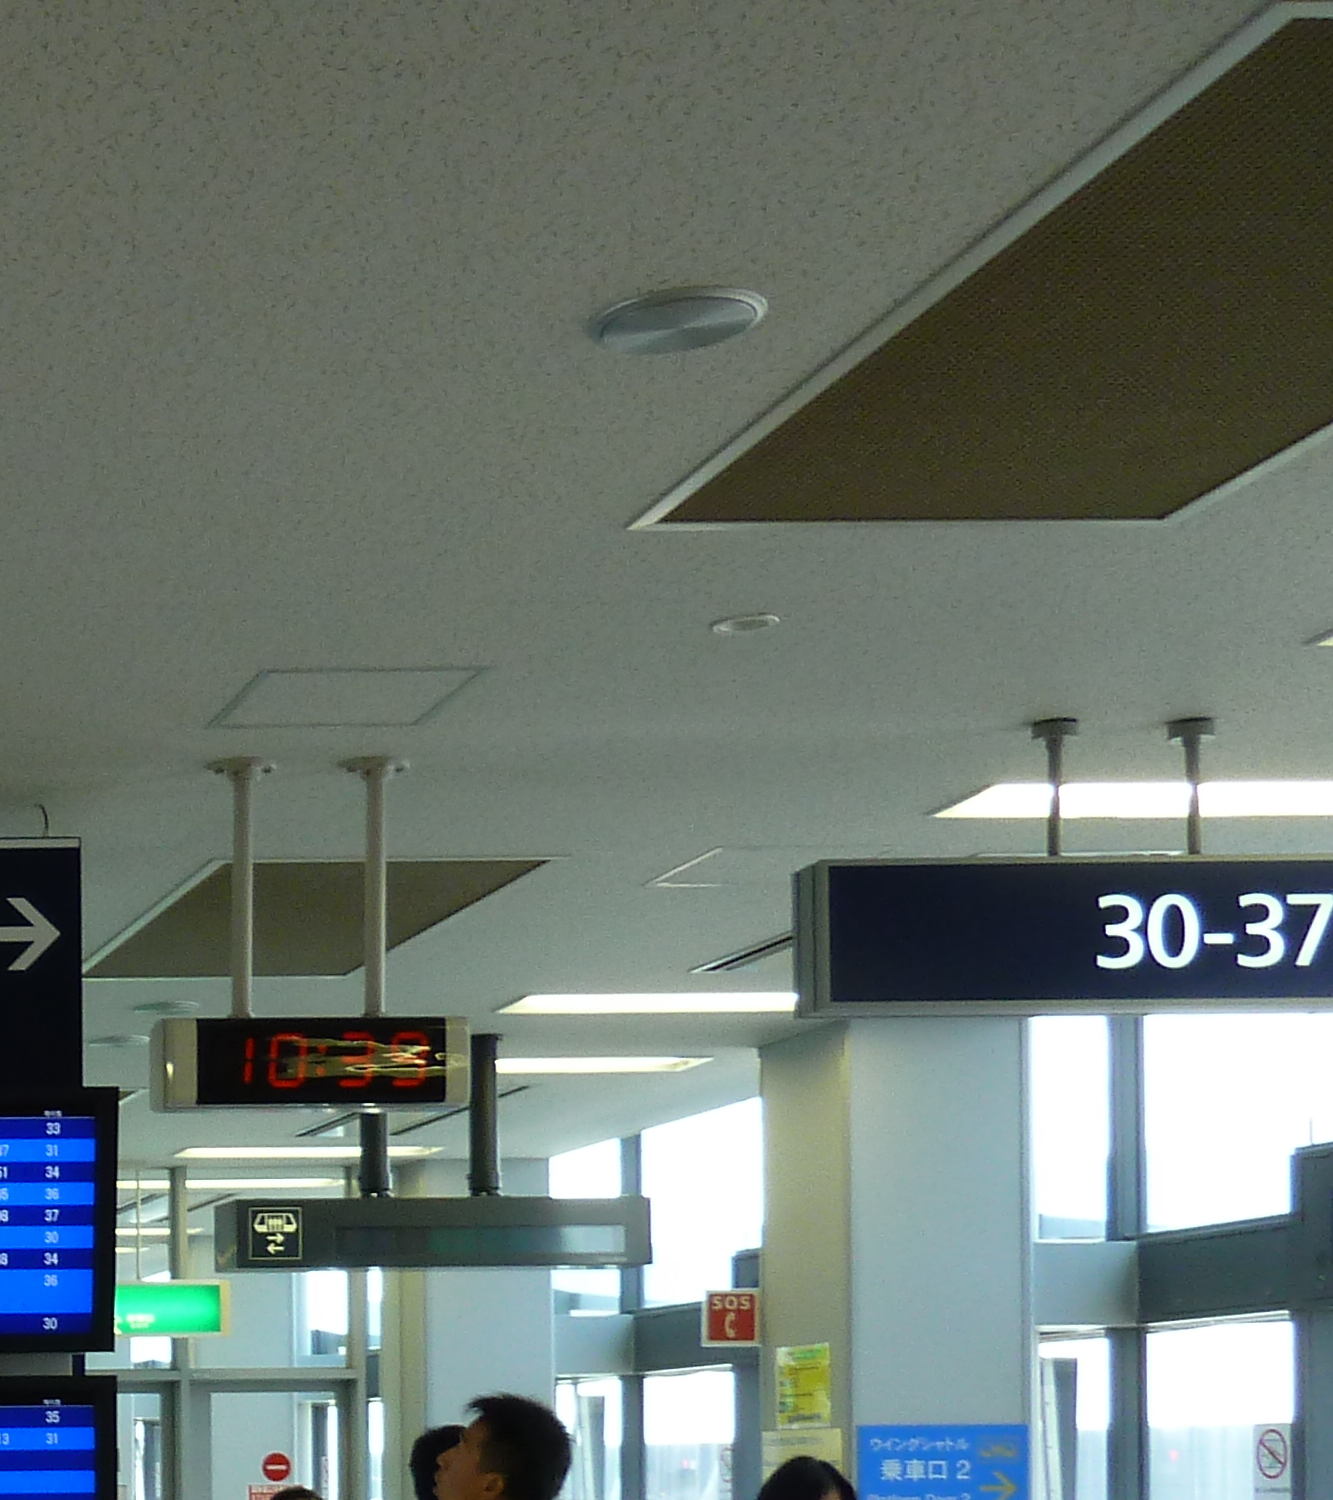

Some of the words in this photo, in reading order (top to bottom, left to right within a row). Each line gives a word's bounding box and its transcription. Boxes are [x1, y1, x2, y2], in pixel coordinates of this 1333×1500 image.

[1096, 893, 1333, 969] 30-37
[46, 1123, 60, 1134] 33
[46, 1166, 59, 1178] 34
[710, 1294, 752, 1310] SOS
[46, 1411, 59, 1422] 35
[880, 1459, 948, 1481] 乗車口
[956, 1460, 971, 1480] 2
